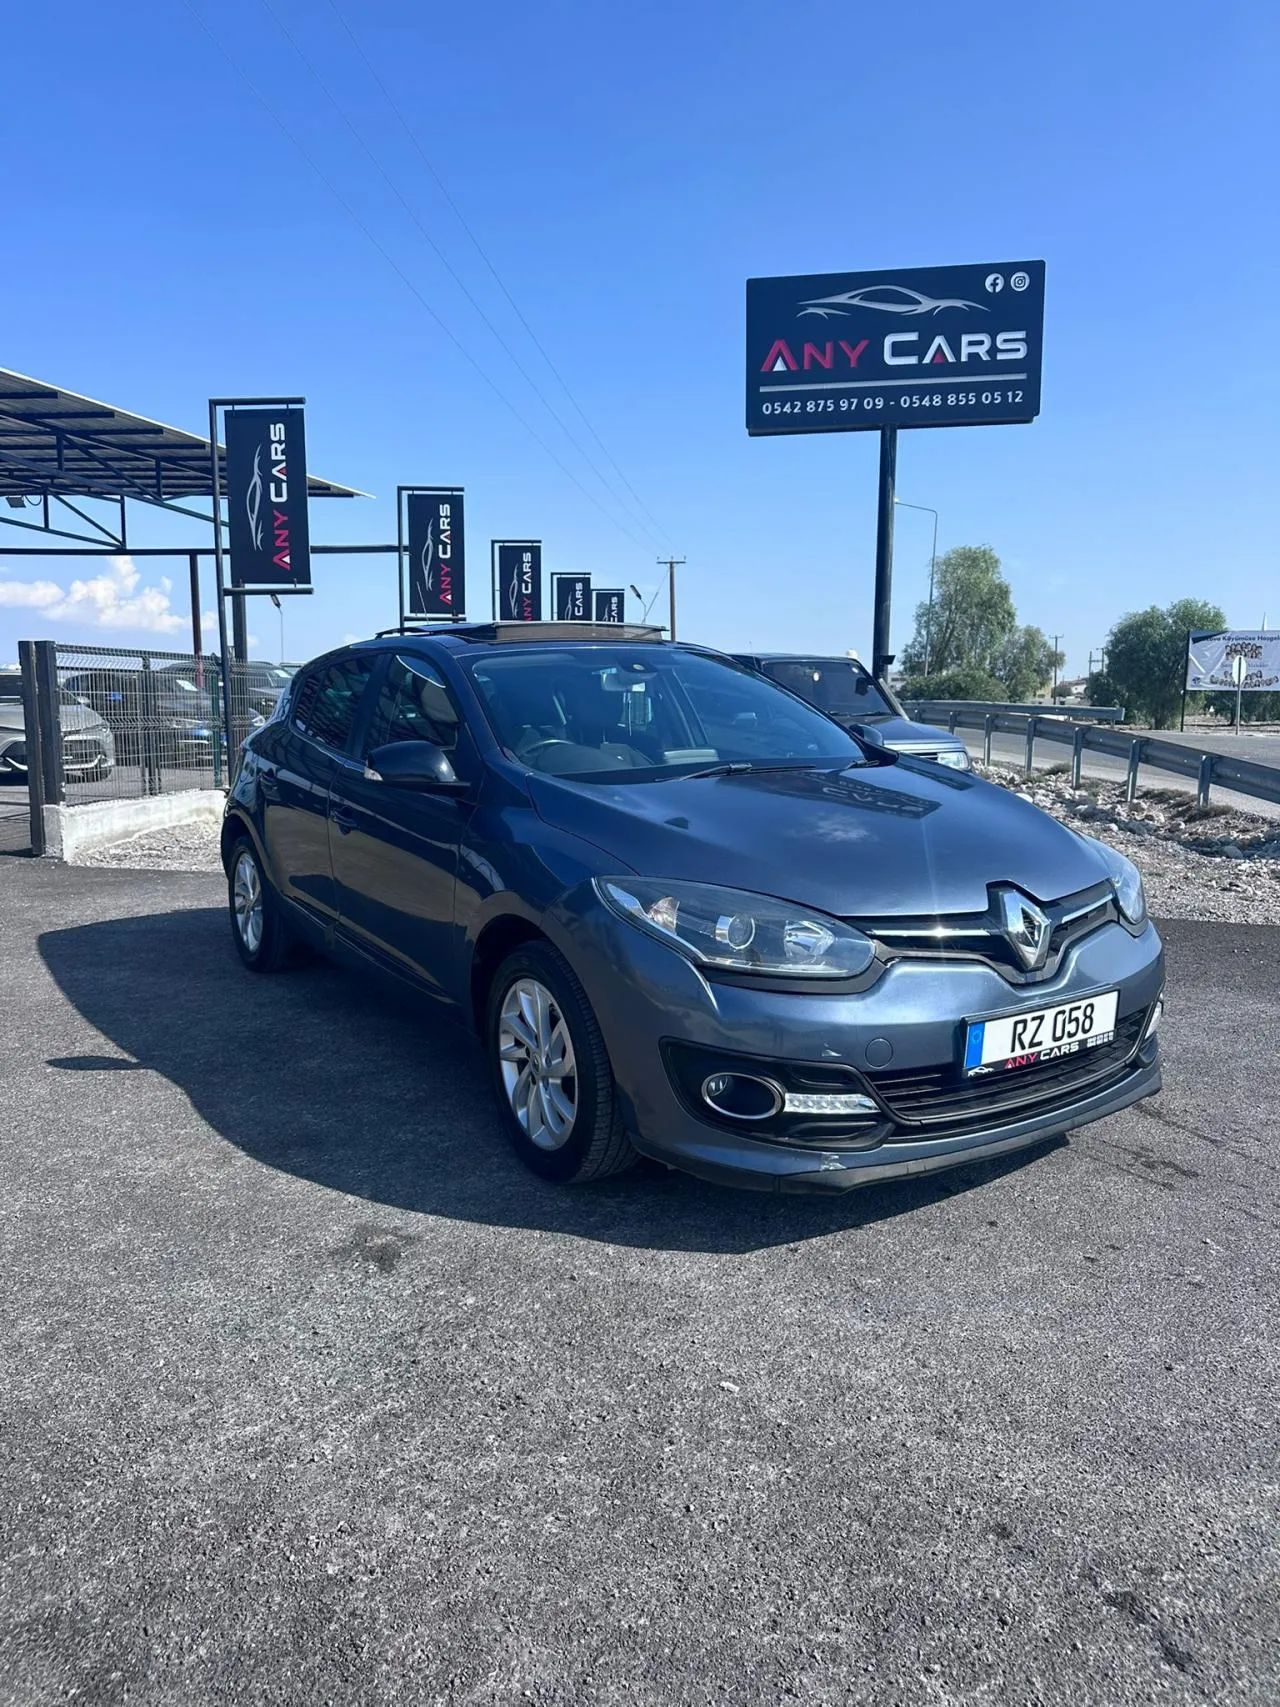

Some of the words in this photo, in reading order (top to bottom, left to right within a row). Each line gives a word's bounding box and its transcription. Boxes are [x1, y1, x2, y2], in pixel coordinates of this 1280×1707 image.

[760, 339, 870, 372] ANY
[883, 330, 1028, 366] CARS
[762, 400, 802, 415] 0542
[806, 399, 835, 413] 875
[839, 398, 858, 411] 97
[863, 396, 884, 410] 09
[901, 394, 942, 408] 0548
[947, 392, 976, 406] 855
[981, 391, 1002, 405] 05
[1007, 390, 1023, 404] 12
[270, 422, 288, 503] CARS
[272, 509, 291, 571] ANY
[438, 503, 451, 559] CARS
[439, 563, 452, 605] ANY
[522, 552, 532, 594] CARS
[574, 582, 583, 616] CARS
[1011, 1014, 1045, 1053] RZ
[1052, 1002, 1095, 1043] 058
[1005, 1053, 1039, 1068] ANY
[1040, 1042, 1079, 1059] CARS
